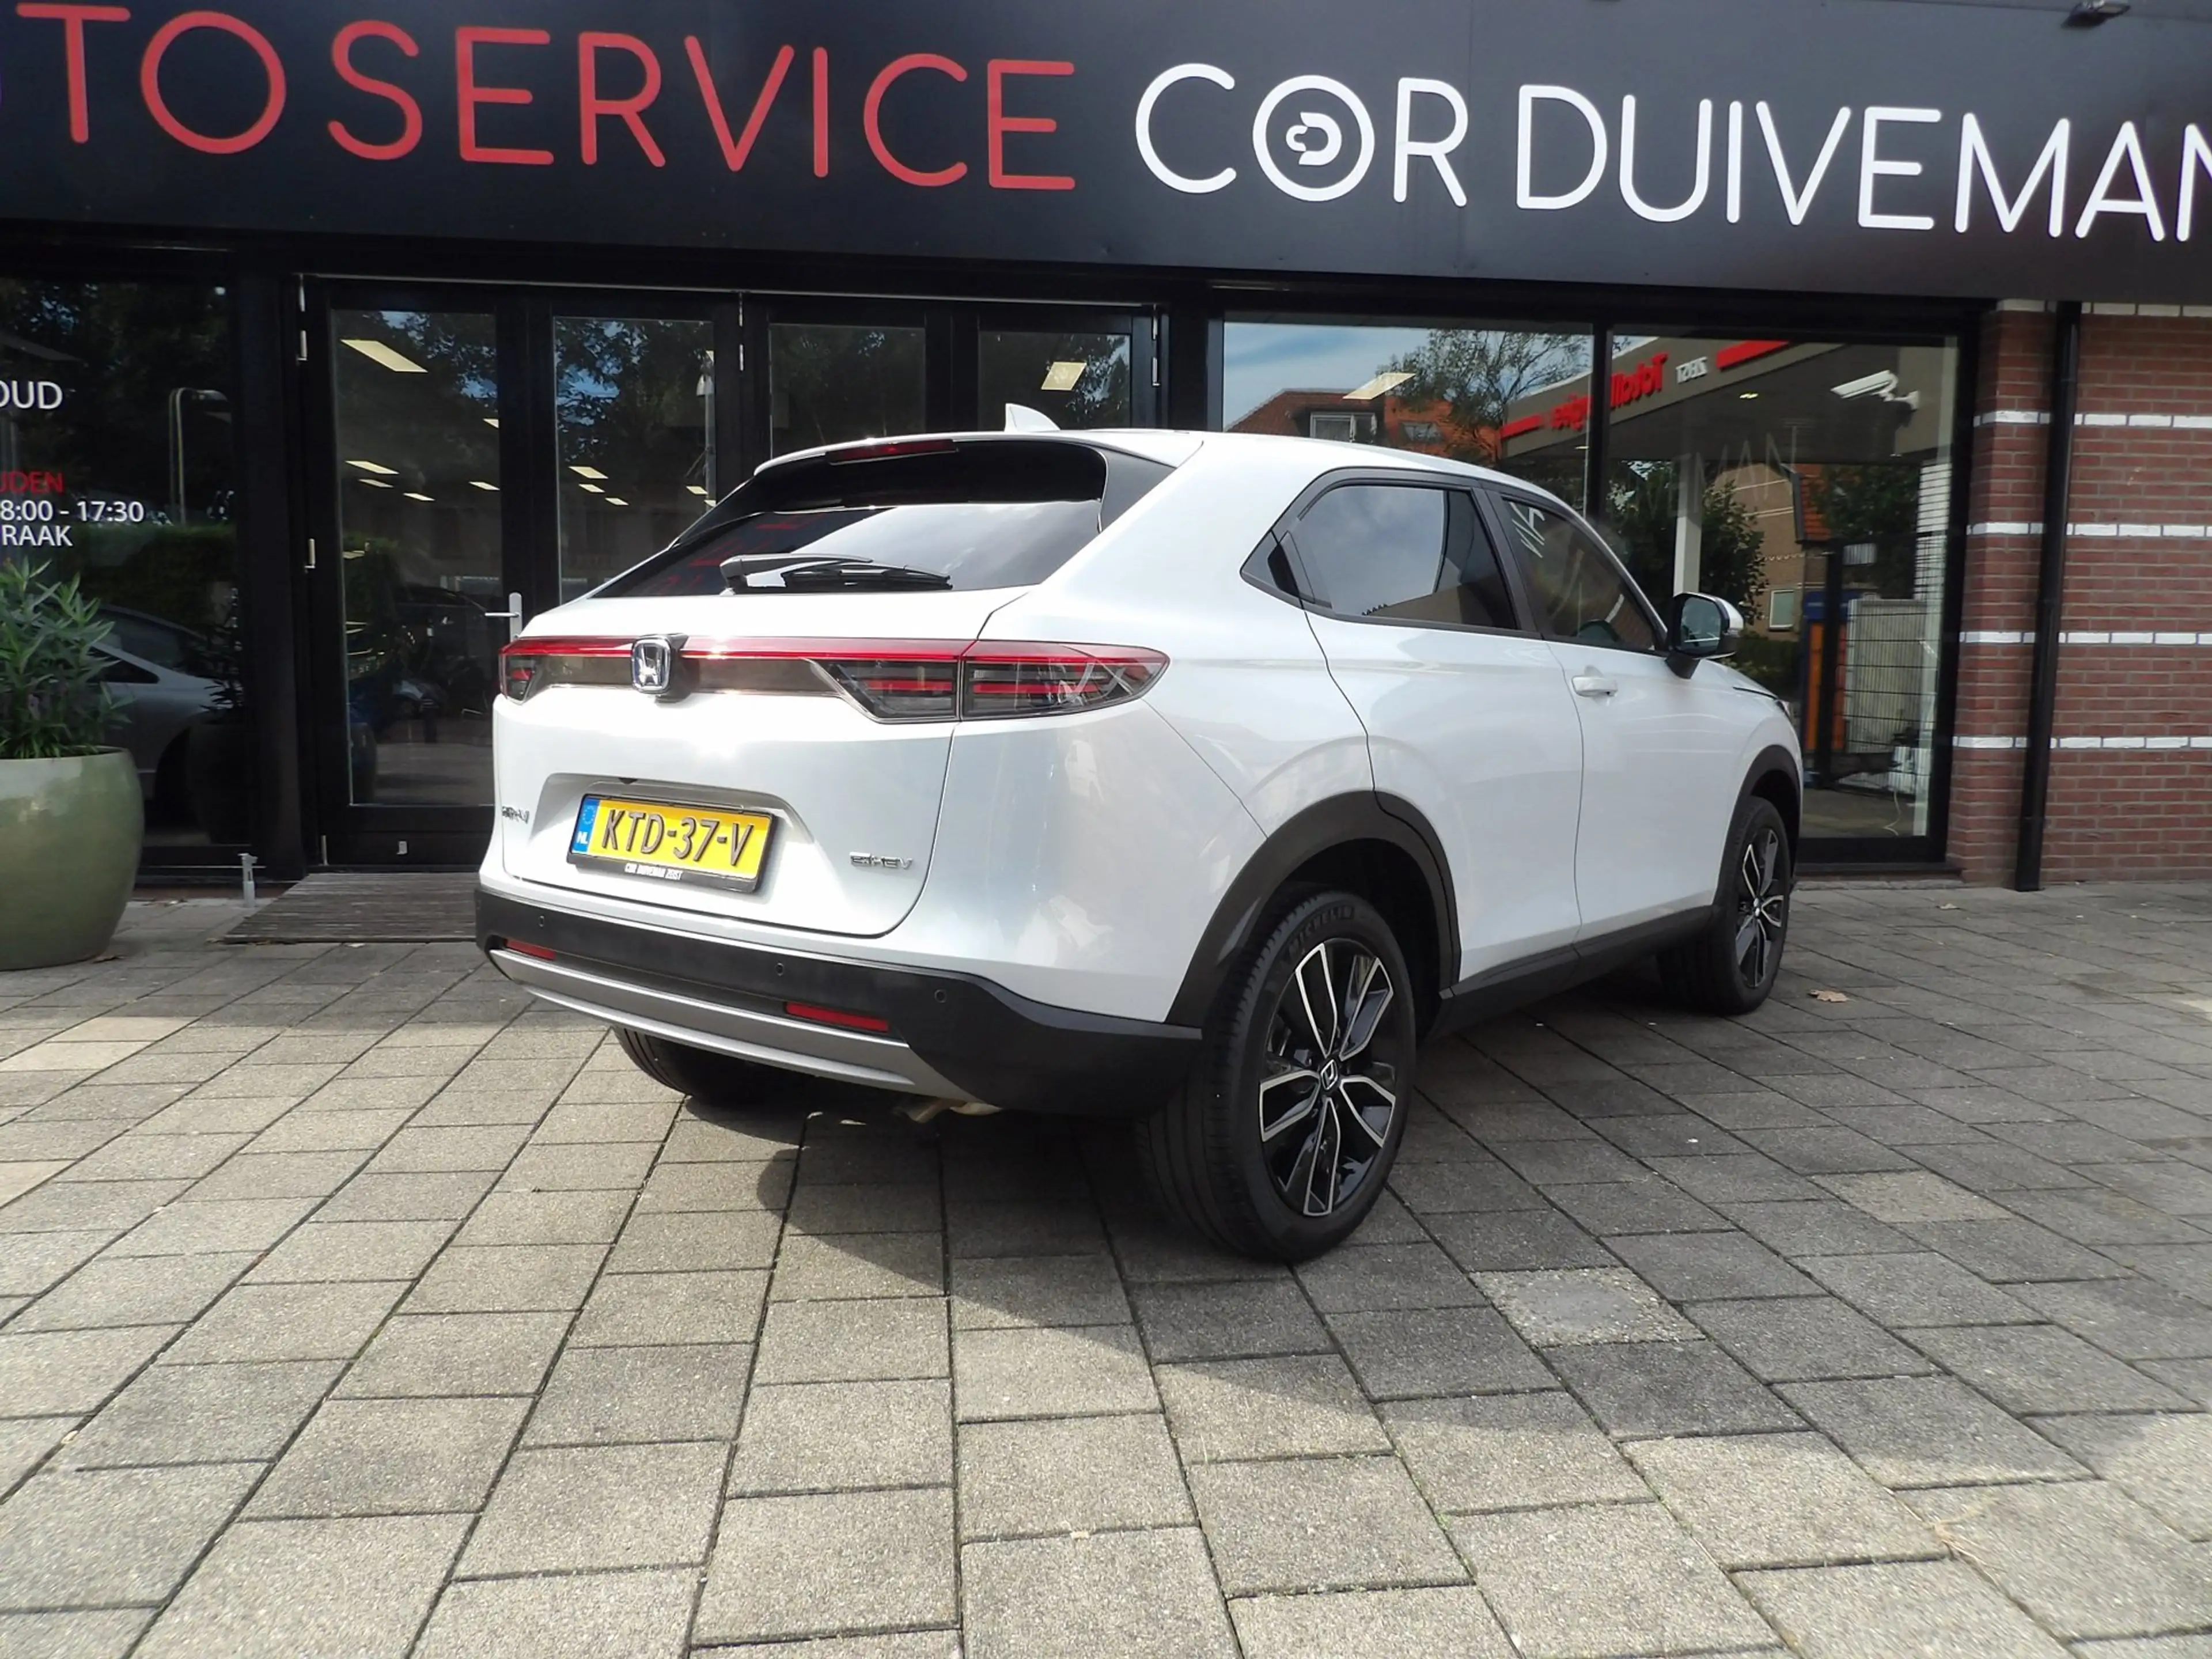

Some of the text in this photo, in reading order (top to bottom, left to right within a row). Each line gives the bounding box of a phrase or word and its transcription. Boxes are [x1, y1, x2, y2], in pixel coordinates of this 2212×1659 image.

[1135, 63, 1468, 207] COR
[1, 499, 53, 522] 8:00
[77, 500, 144, 523] 17:30
[2, 525, 73, 547] RAAK
[577, 809, 754, 866] NL KTD-37-V
